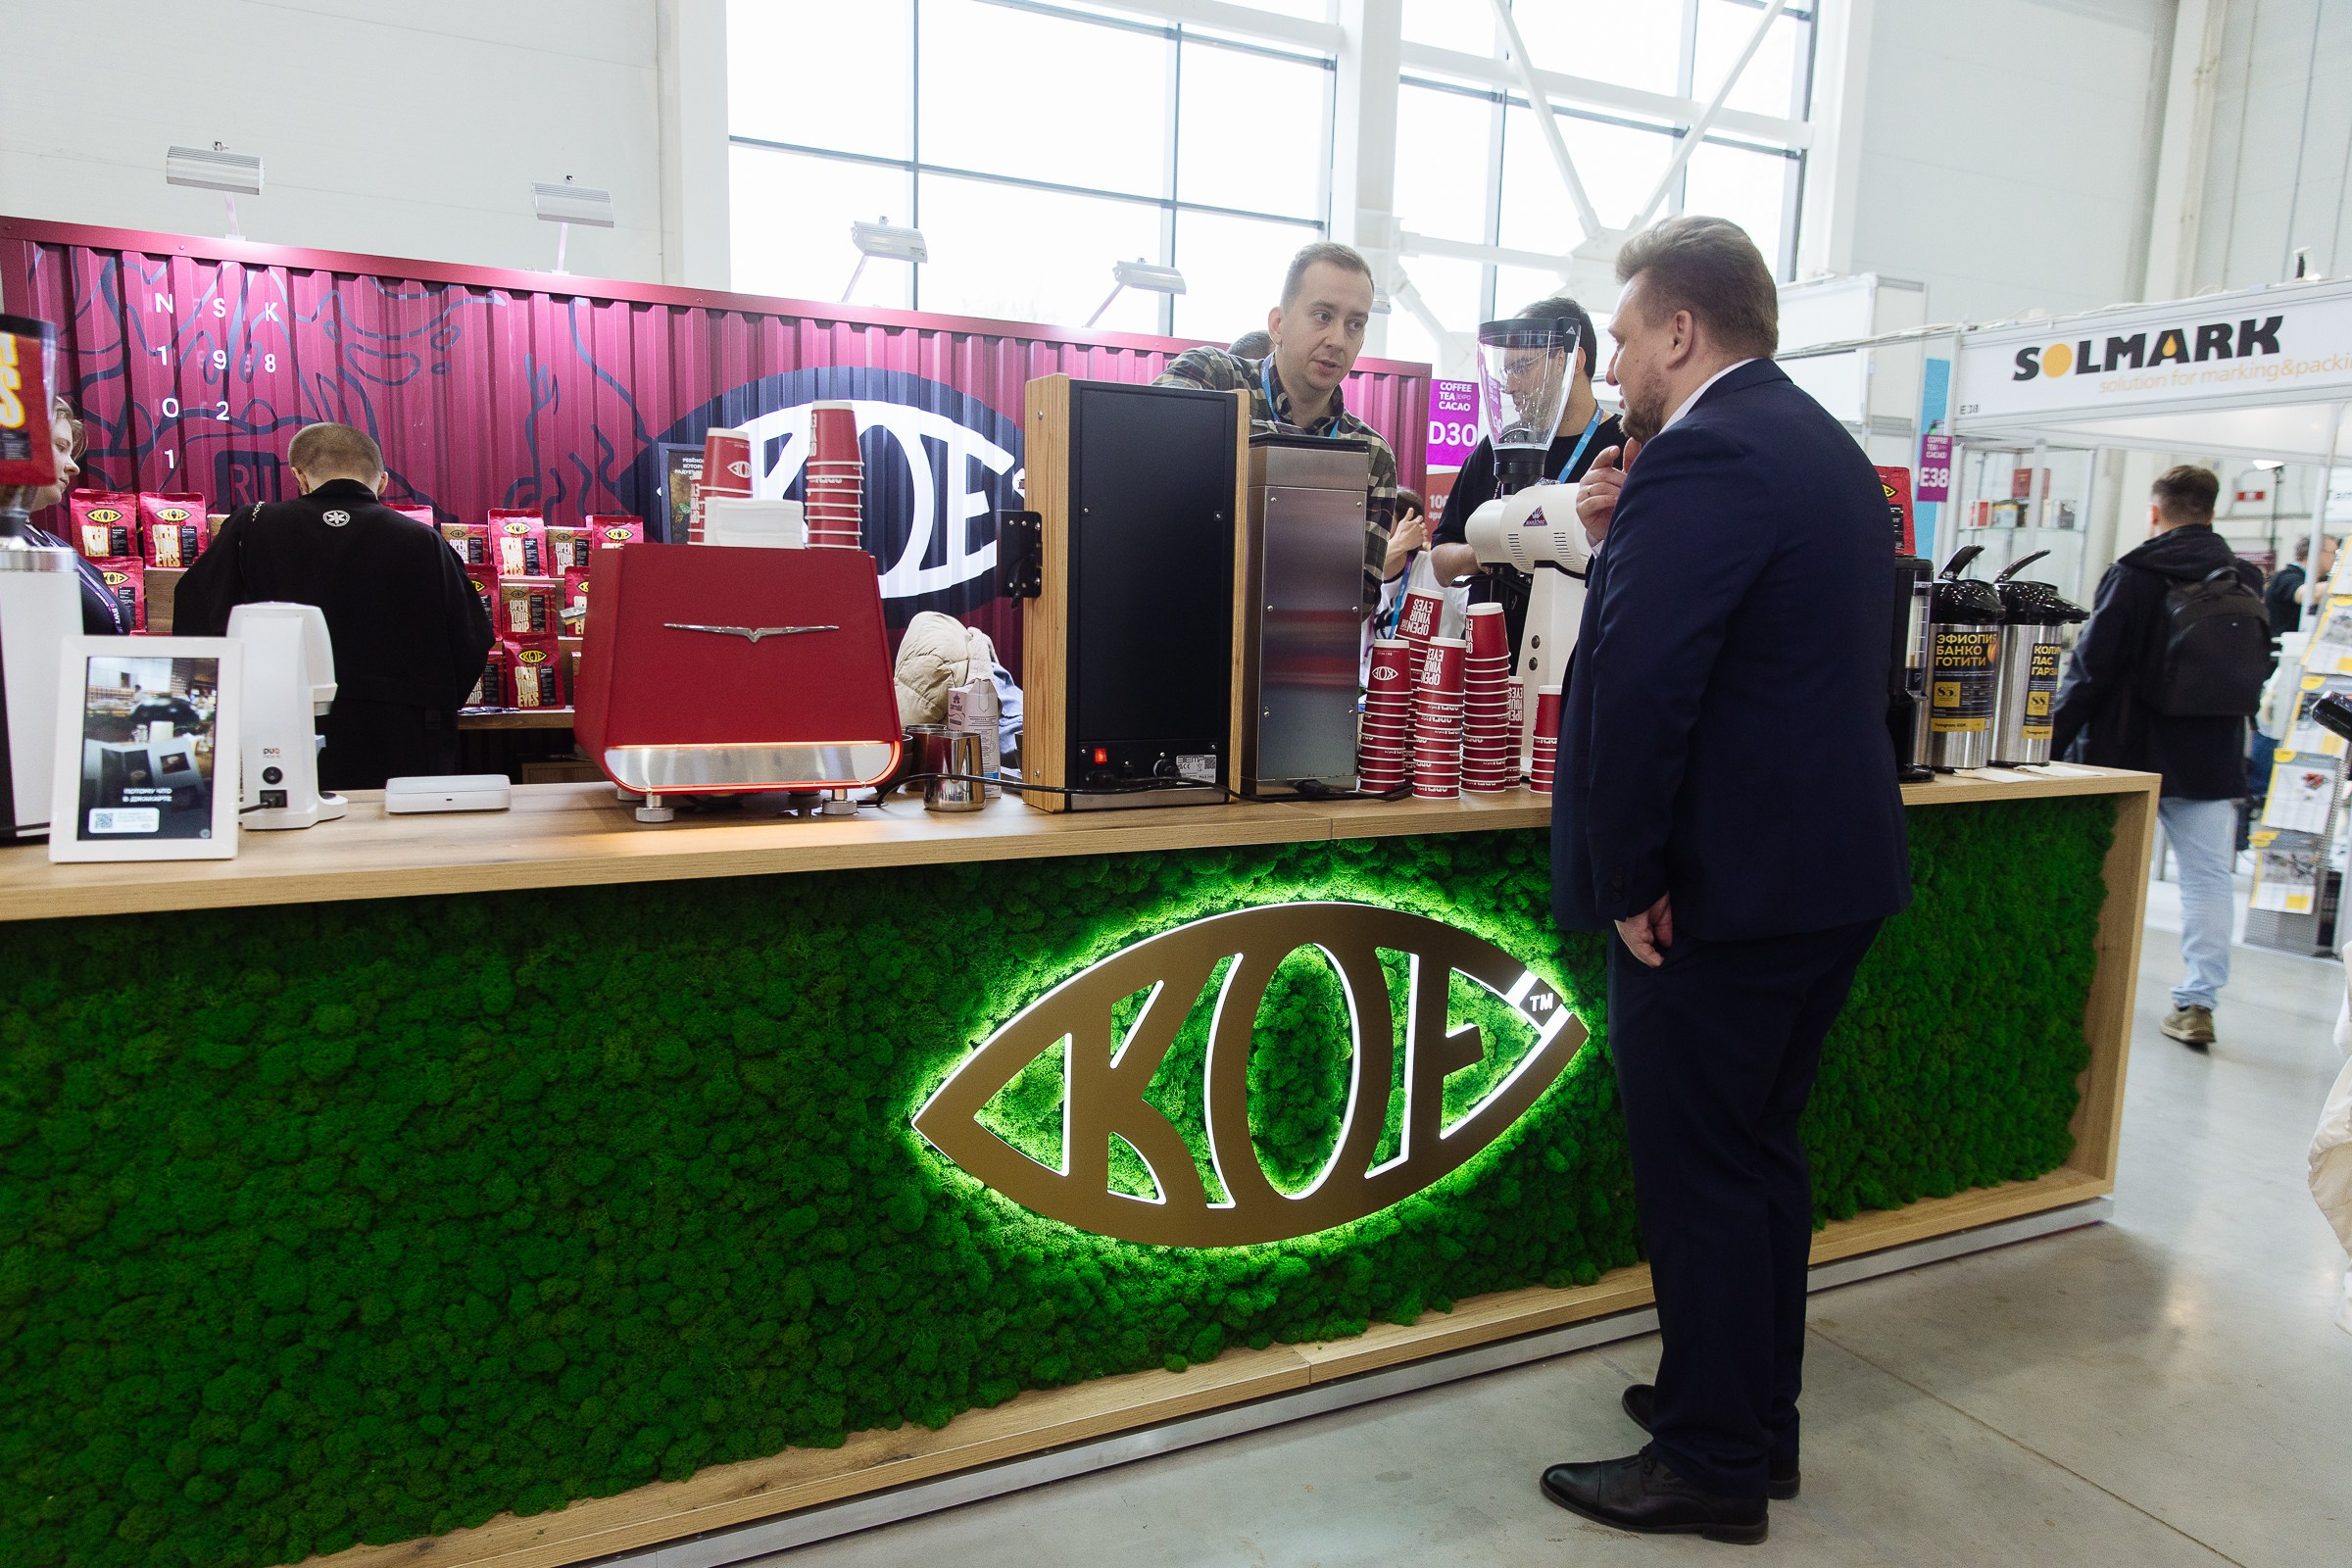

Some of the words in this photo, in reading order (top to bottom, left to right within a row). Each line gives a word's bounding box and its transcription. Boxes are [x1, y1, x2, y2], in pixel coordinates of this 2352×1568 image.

[2099, 374, 2168, 394] solution
[2172, 370, 2196, 387] for
[2204, 351, 2352, 383] marking&packi
[1440, 382, 1472, 393] COFFEE
[1439, 391, 1455, 401] TEA
[1438, 401, 1471, 412] CACAO
[1428, 420, 1478, 447] D30
[1920, 466, 1949, 488] E38
[229, 464, 272, 507] RU
[555, 542, 572, 553] OPEN
[510, 600, 528, 611] OPEN
[1412, 598, 1434, 613] EYES
[511, 611, 529, 624] YOUR
[1409, 610, 1431, 625] YOUR
[1407, 620, 1430, 636] OPEN
[517, 649, 548, 662] KOE
[1426, 648, 1445, 662] EYES
[1936, 645, 1983, 656] БАНКО
[1936, 657, 1986, 666] ГОТИТИ
[2032, 657, 2054, 665] ЛАС
[1372, 666, 1399, 680] KOE
[515, 677, 539, 692] YOUR
[517, 692, 540, 707] EYES
[1528, 994, 1555, 1012] TM
